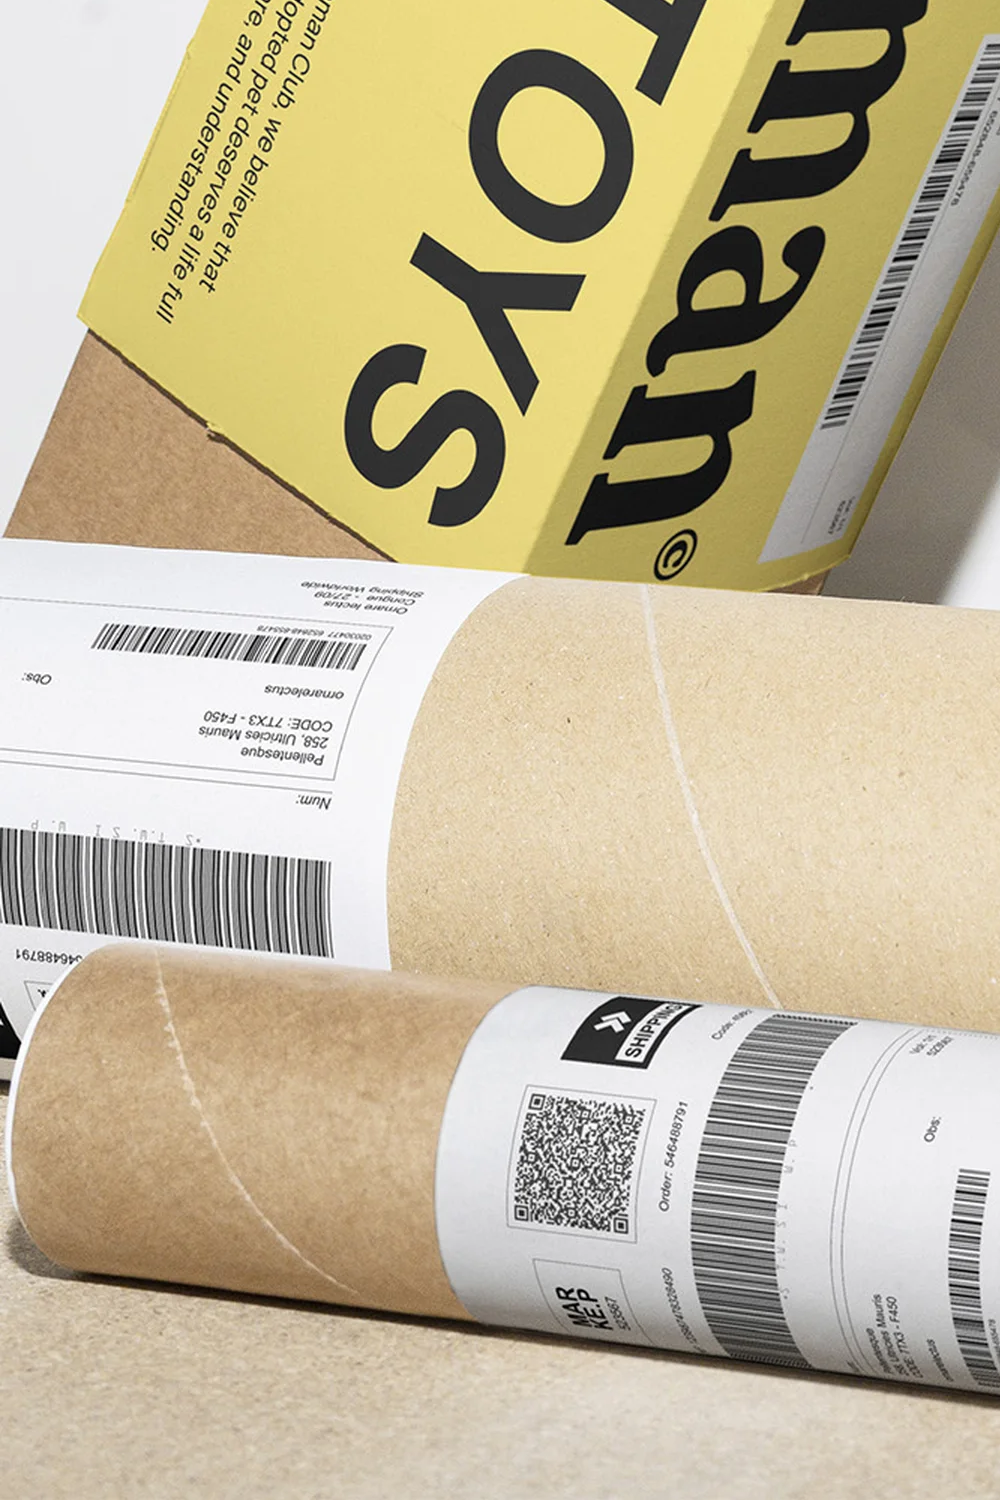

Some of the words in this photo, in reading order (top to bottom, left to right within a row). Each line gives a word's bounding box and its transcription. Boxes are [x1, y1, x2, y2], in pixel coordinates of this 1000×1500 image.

[225, 33, 253, 85] and
[241, 68, 269, 117] pet
[271, 53, 310, 109] Club,
[257, 118, 282, 153] we
[150, 82, 234, 252] understanding.
[197, 116, 250, 224] deserves
[221, 154, 269, 239] believe
[188, 224, 204, 242] a
[173, 242, 201, 281] life
[198, 241, 232, 294] that
[156, 282, 183, 324] full
[21, 672, 52, 686] Obs:
[203, 710, 238, 725] F450
[248, 714, 284, 729] 7TX3
[287, 717, 333, 733] CODE:
[240, 746, 325, 767] Pellentesque
[295, 794, 332, 810] Num:
[663, 1101, 688, 1169] 546488791
[923, 1116, 942, 1143] Obs:
[658, 1171, 673, 1212] Order:
[556, 1287, 593, 1328] MAR
[577, 1289, 614, 1331] KE.P
